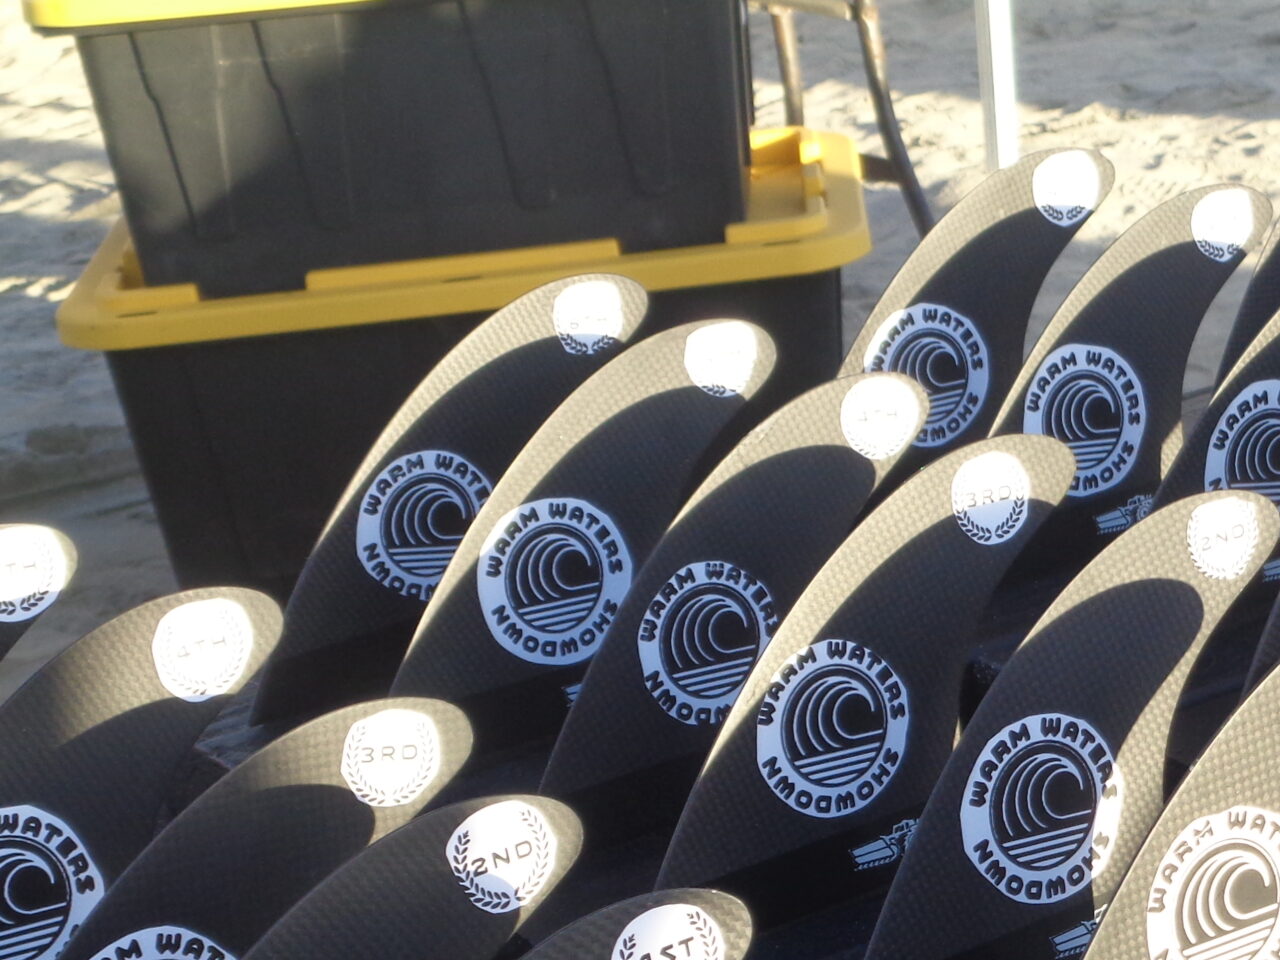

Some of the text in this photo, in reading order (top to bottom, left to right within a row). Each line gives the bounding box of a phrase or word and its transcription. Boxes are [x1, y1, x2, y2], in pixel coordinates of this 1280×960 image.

[922, 308, 984, 371] WATERS
[1027, 350, 1141, 426] WARM WATERS
[1213, 390, 1268, 450] WARM
[363, 455, 424, 516] WARM
[485, 502, 624, 578] WARM WATERS
[491, 598, 618, 657] SHOWDOWN
[639, 567, 696, 642] WARM
[758, 640, 905, 726] WARM WATERS
[361, 744, 418, 764] 3RD
[762, 747, 899, 814] SHOWDOWN
[969, 717, 1118, 808] WARM WATERS
[0, 812, 95, 894] WATERS
[471, 840, 533, 878] 2ND
[973, 831, 1110, 901] SHOWDOWN
[1146, 820, 1213, 913] WARM
